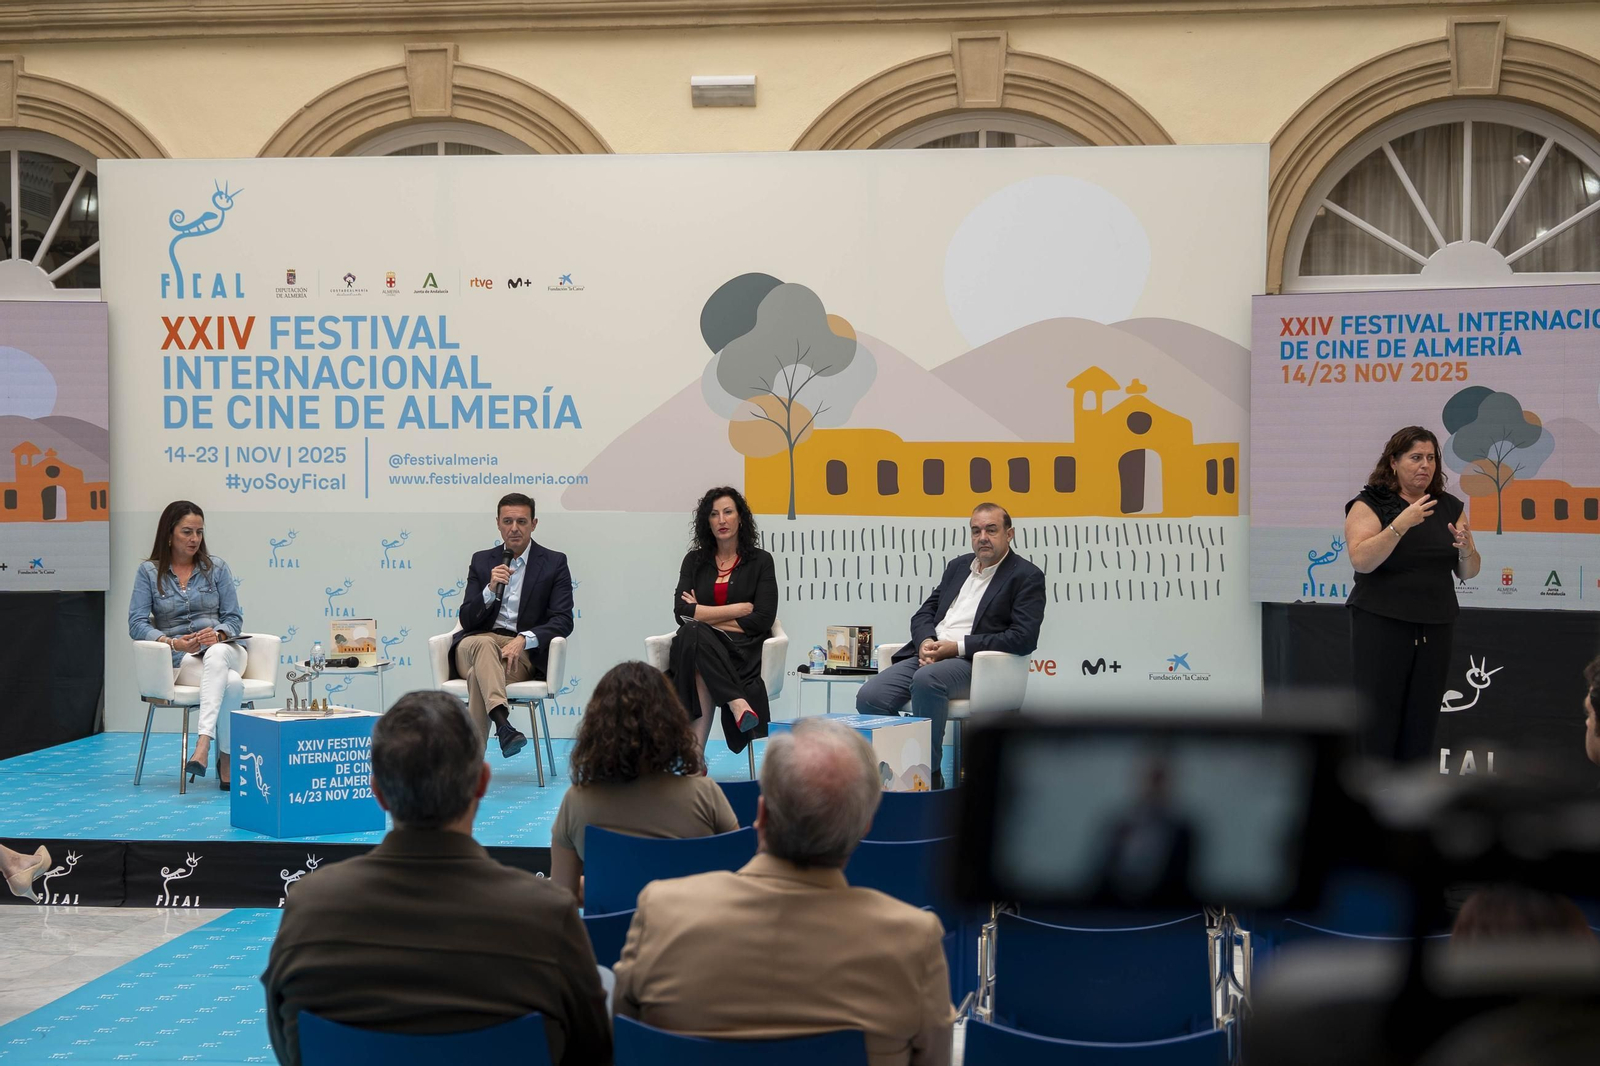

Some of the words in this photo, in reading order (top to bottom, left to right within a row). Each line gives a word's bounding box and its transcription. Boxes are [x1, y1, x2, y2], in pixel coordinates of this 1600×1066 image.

[161, 273, 245, 299] FICAL
[470, 278, 493, 289] rtve
[161, 316, 256, 350] XXIV
[270, 315, 460, 350] FESTIVAL
[1280, 316, 1333, 336] XXIV
[1341, 313, 1450, 335] FESTIVAL
[1280, 341, 1308, 360] DE
[1316, 340, 1369, 360] CINE
[1377, 339, 1406, 358] DE
[1413, 332, 1522, 358] ALMERÍA
[164, 355, 492, 390] INTERNACIONAL
[1282, 362, 1346, 386] 14/23
[1355, 363, 1403, 382] NOV
[1411, 362, 1468, 382] 2025
[164, 395, 213, 429] DE
[227, 395, 319, 429] CINE
[335, 395, 384, 429] DE
[397, 386, 582, 429] ALMERÍA
[164, 446, 219, 463] 14-23
[237, 446, 281, 463] NOV
[298, 446, 346, 463] 2025
[389, 454, 498, 468] @festivalmeria
[226, 473, 346, 493] #yoSoyFical
[389, 473, 588, 485] www.festivaldealmeria.com
[269, 559, 300, 568] FICAL
[381, 560, 412, 569] FICAL
[1303, 583, 1347, 597] FICAL
[325, 608, 355, 616] FICAL
[298, 739, 324, 751] XXIV
[328, 737, 372, 750] FESTIVA
[289, 749, 372, 765] INTERNACIONA
[336, 764, 350, 775] DE
[354, 762, 372, 774] CIN
[312, 778, 326, 789] DE
[330, 773, 372, 788] ALMERÍ
[289, 790, 322, 804] 14/23
[326, 790, 349, 801] NOV
[352, 788, 376, 799] 202
[156, 894, 200, 907] FICAL
